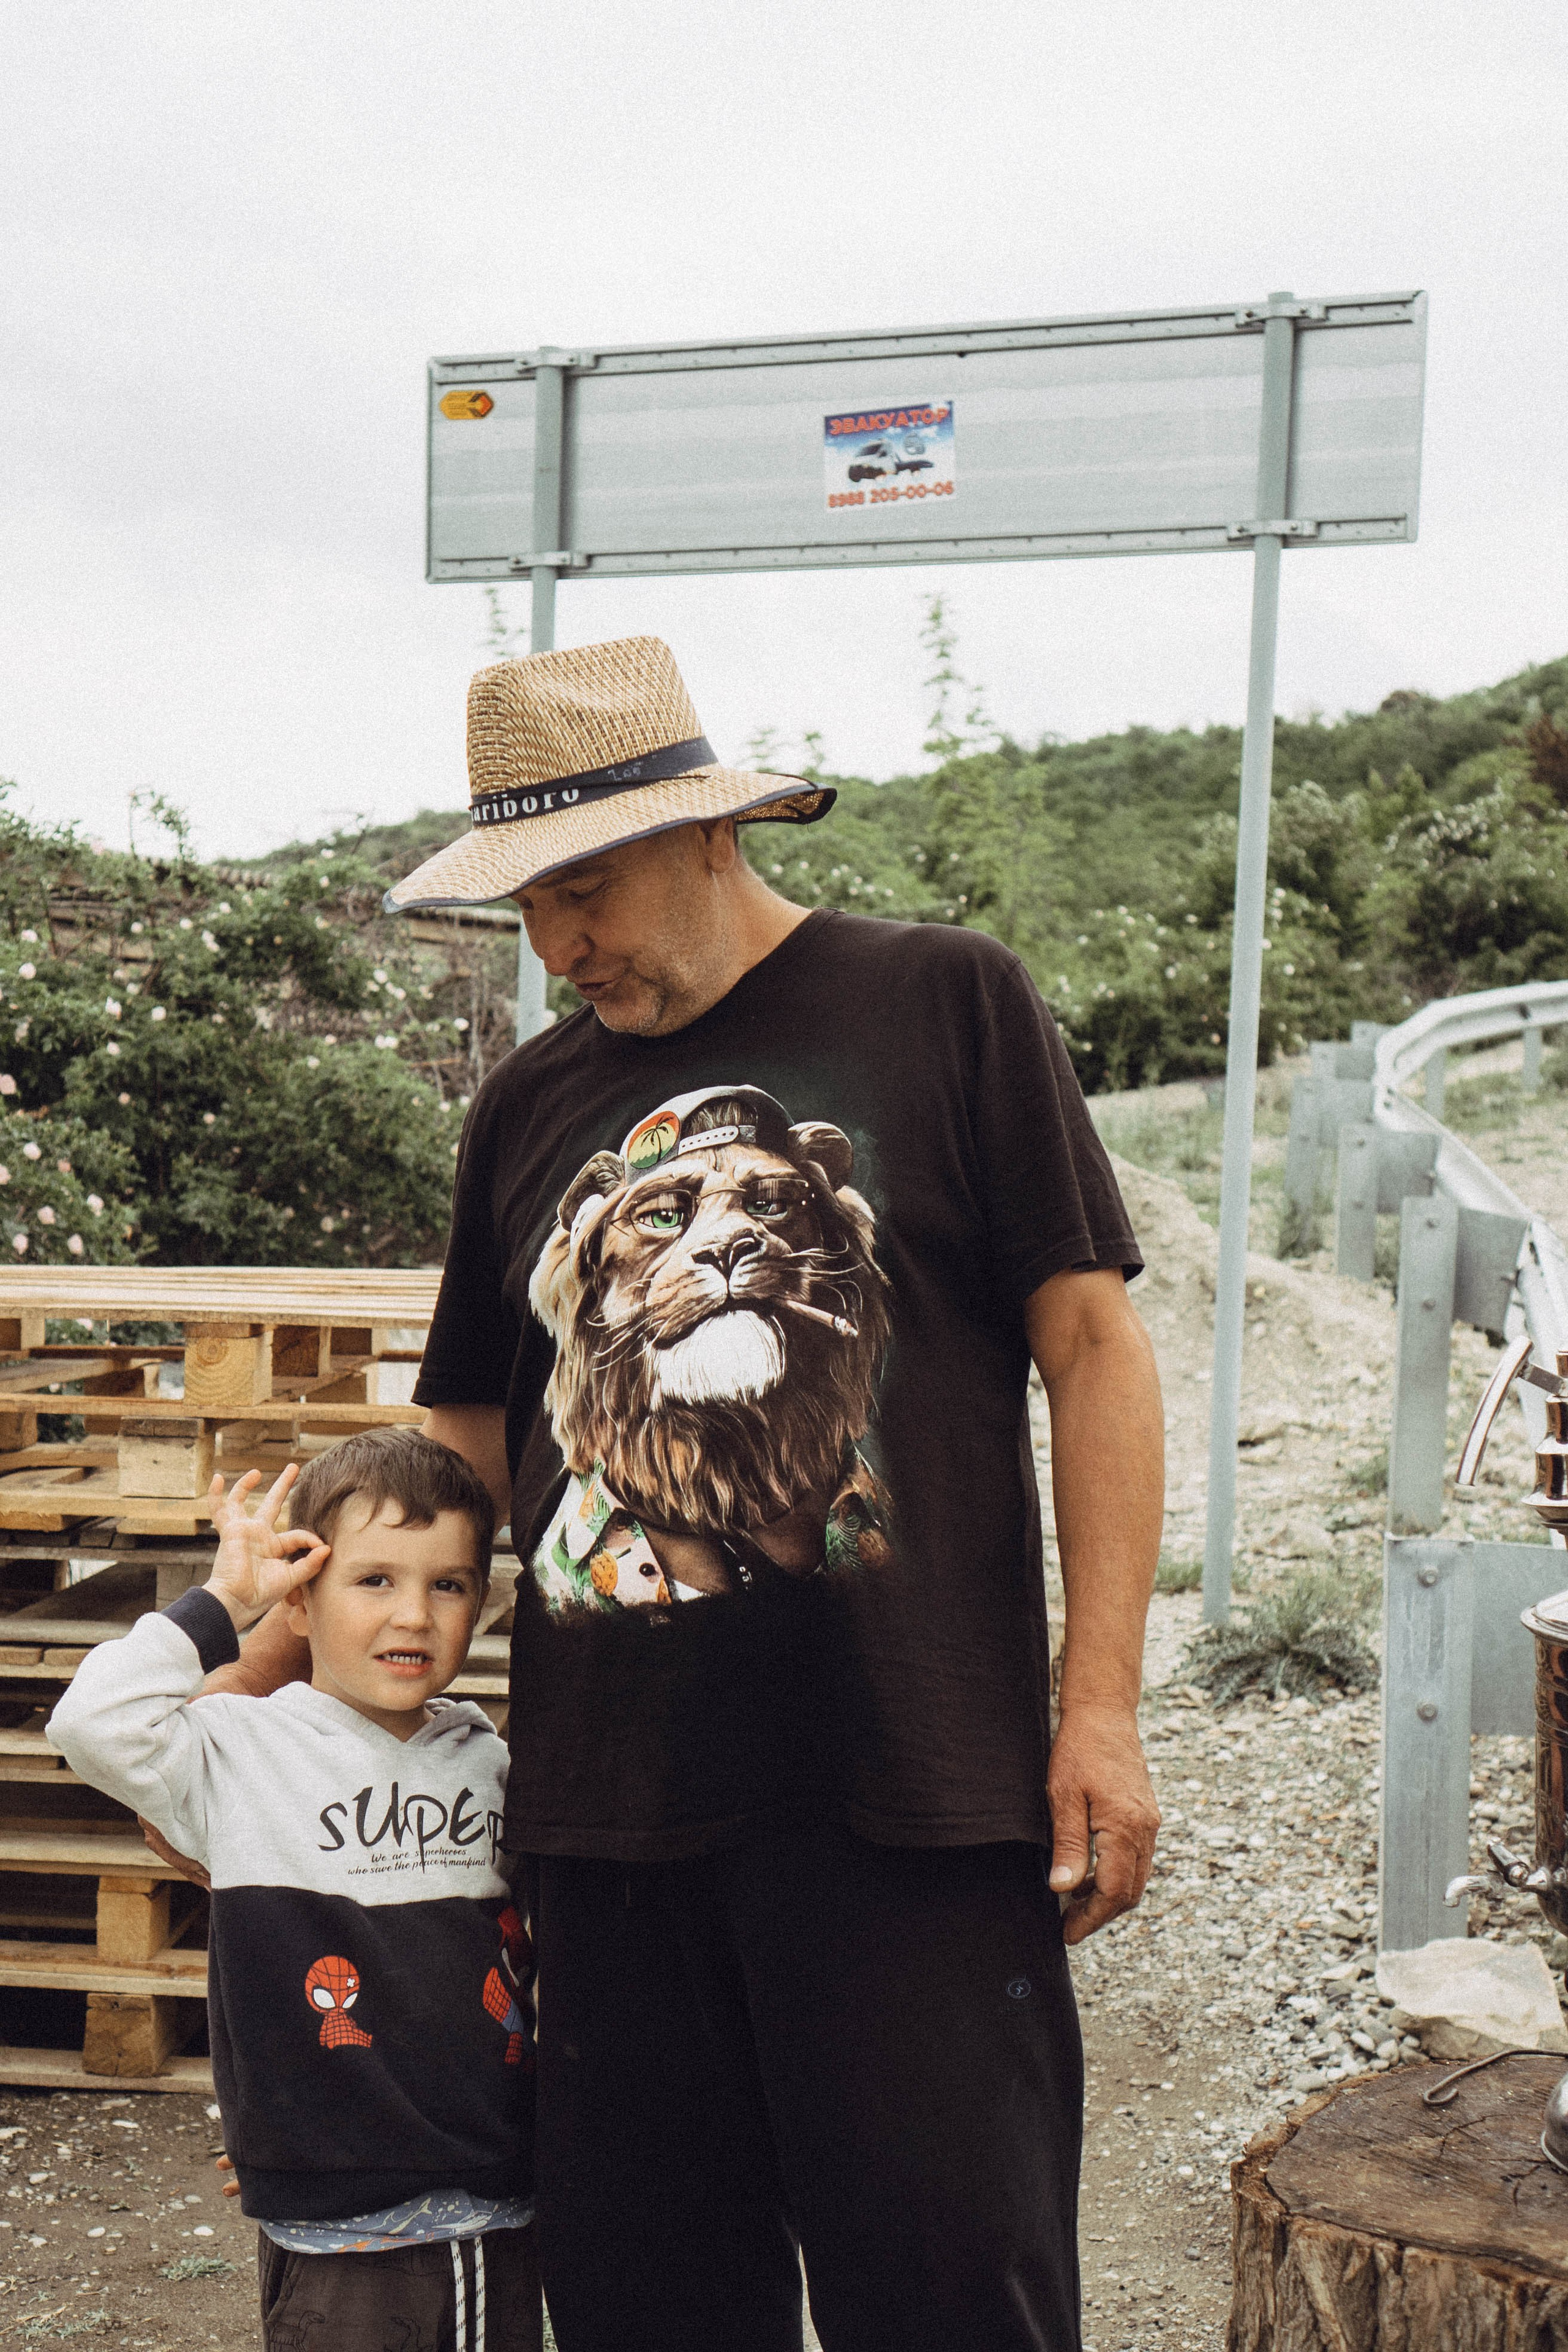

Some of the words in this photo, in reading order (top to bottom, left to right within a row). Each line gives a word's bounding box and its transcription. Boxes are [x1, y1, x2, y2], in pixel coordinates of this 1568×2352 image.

[830, 407, 948, 435] ЭВАКУАТОР
[371, 1853, 386, 1863] We
[392, 1851, 409, 1860] are
[415, 1847, 467, 1858] sperheroes
[348, 1866, 368, 1874] who
[371, 1865, 392, 1874] save
[394, 1861, 410, 1871] the
[440, 1857, 448, 1868] of
[449, 1857, 486, 1869] mankind
